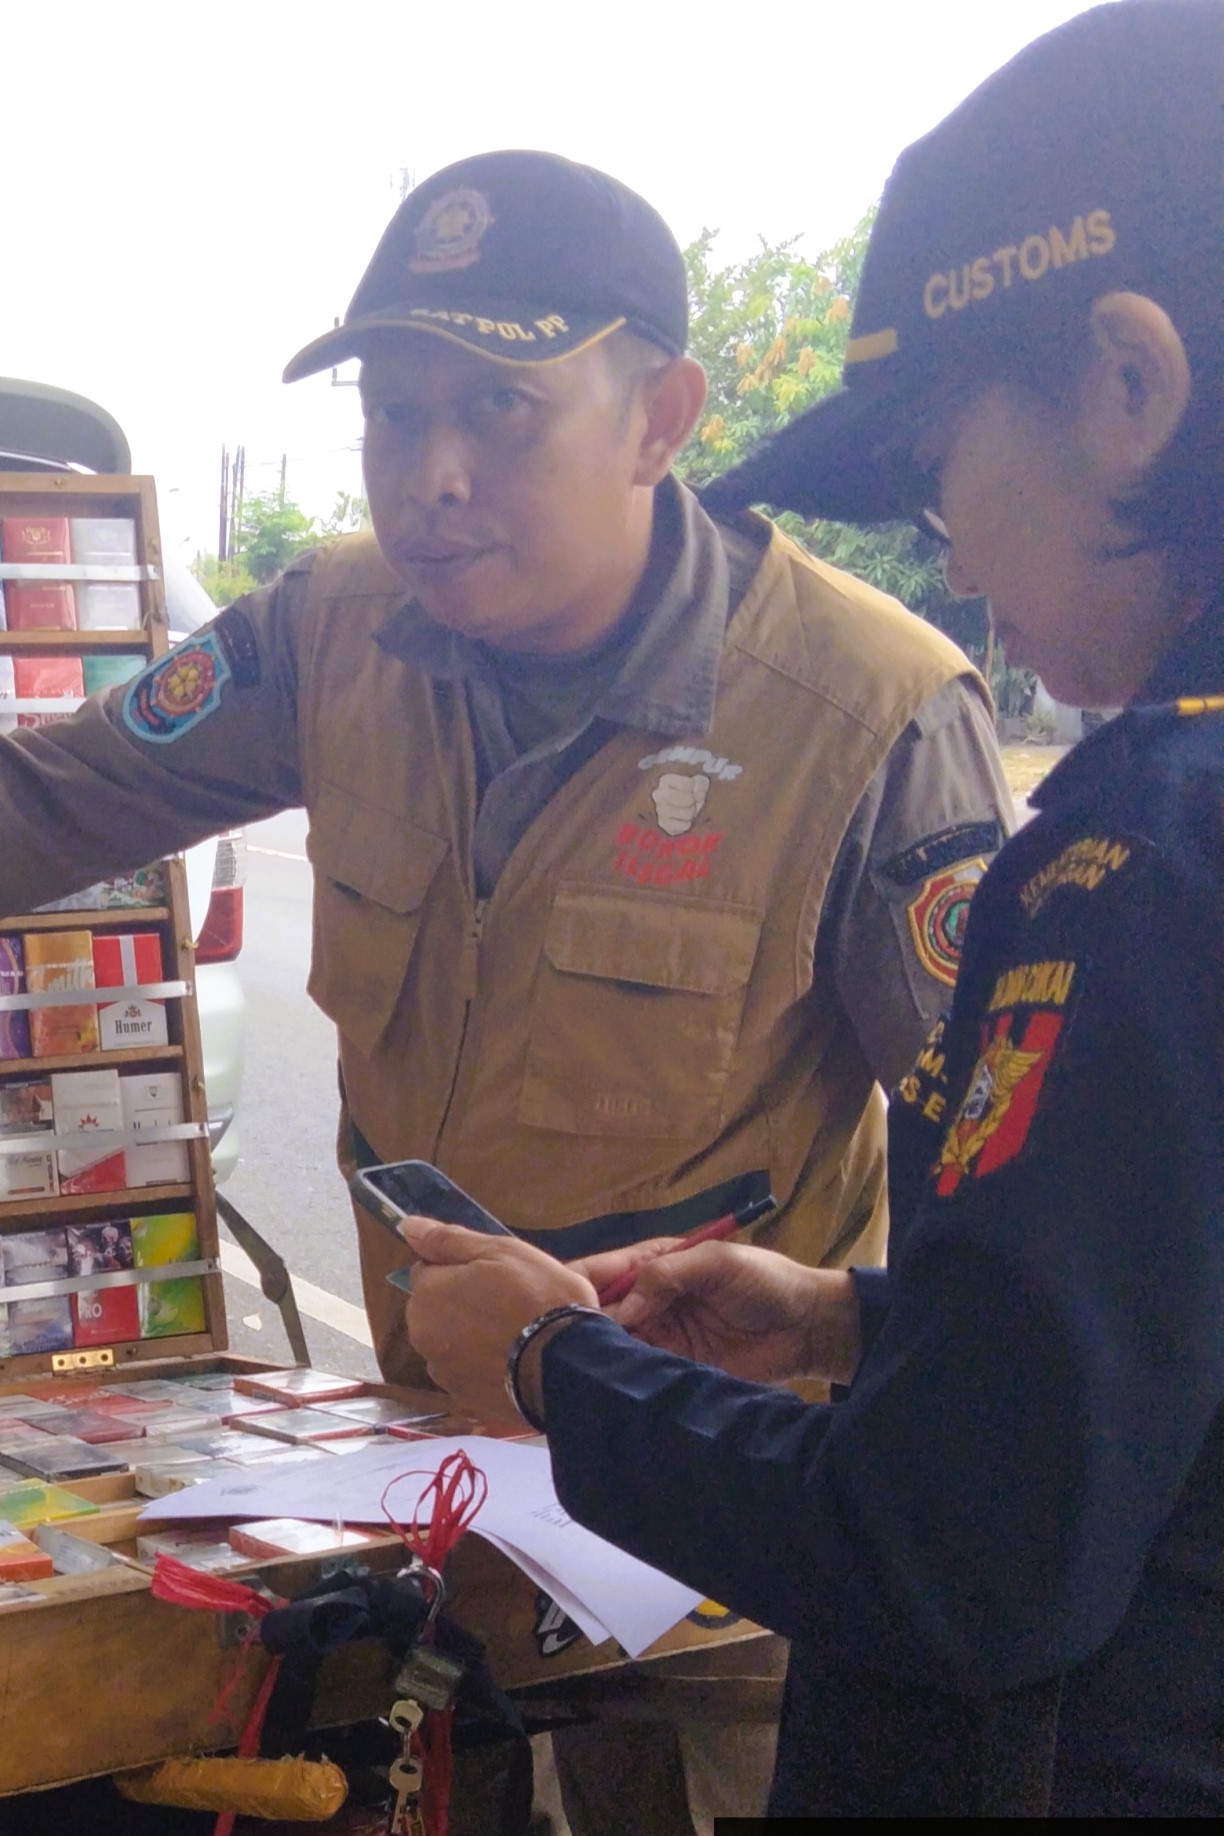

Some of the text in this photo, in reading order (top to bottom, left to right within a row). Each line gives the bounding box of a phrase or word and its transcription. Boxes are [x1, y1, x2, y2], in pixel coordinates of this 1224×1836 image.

[924, 208, 1117, 319] CUSTOMS
[534, 313, 569, 338] PP
[114, 1019, 153, 1035] Humer
